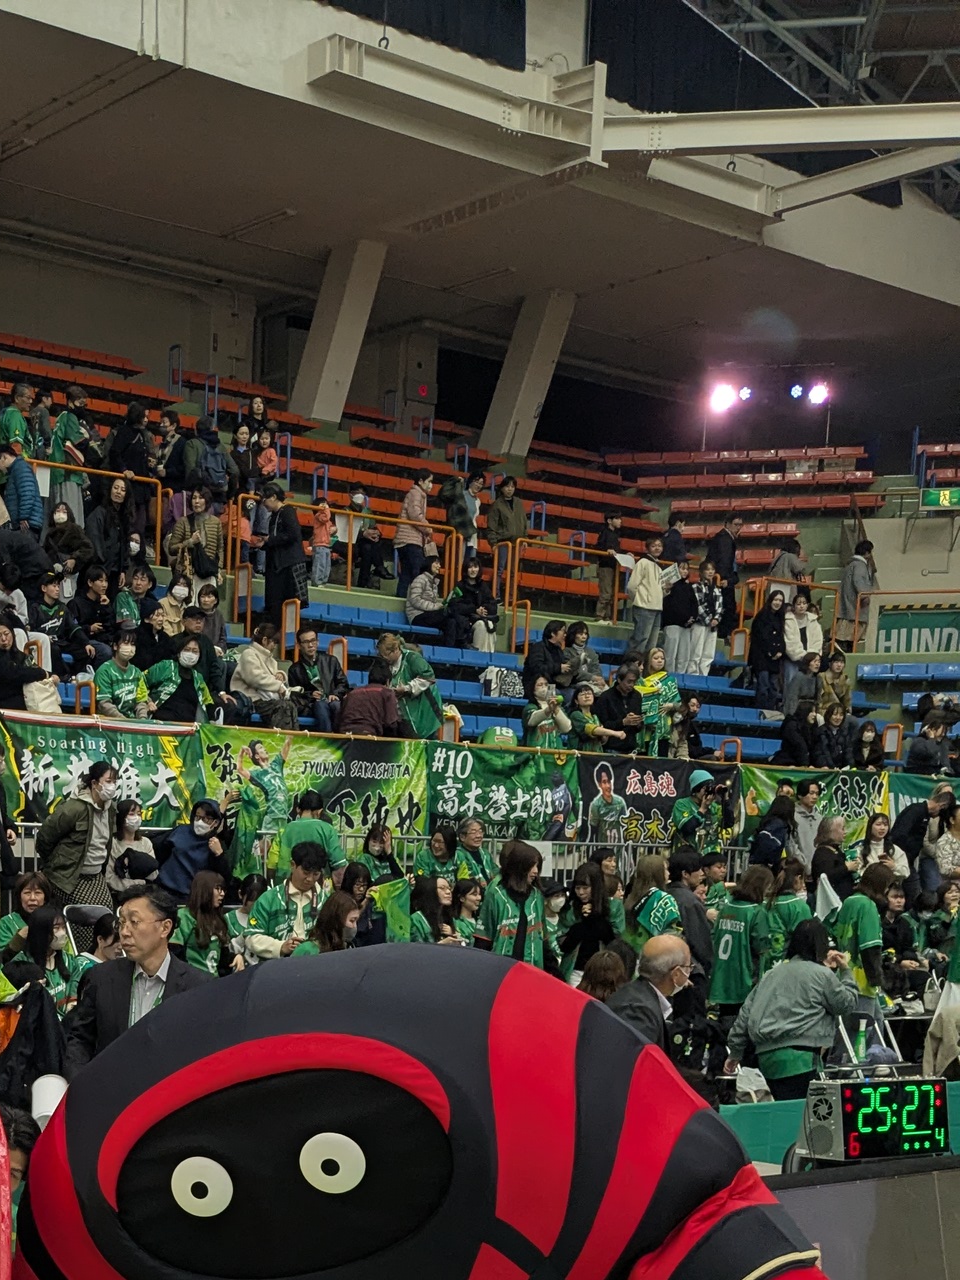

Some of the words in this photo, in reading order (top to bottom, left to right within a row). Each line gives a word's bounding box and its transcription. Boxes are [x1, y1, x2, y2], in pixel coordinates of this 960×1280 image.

[878, 627, 960, 653] HUND
[494, 726, 514, 737] 18
[37, 735, 108, 753] Soaring
[116, 741, 155, 758] High
[300, 759, 346, 778] JYUNYA
[349, 759, 412, 780] SAKASHITA
[432, 747, 474, 779] #10
[625, 768, 678, 797] 広島魂
